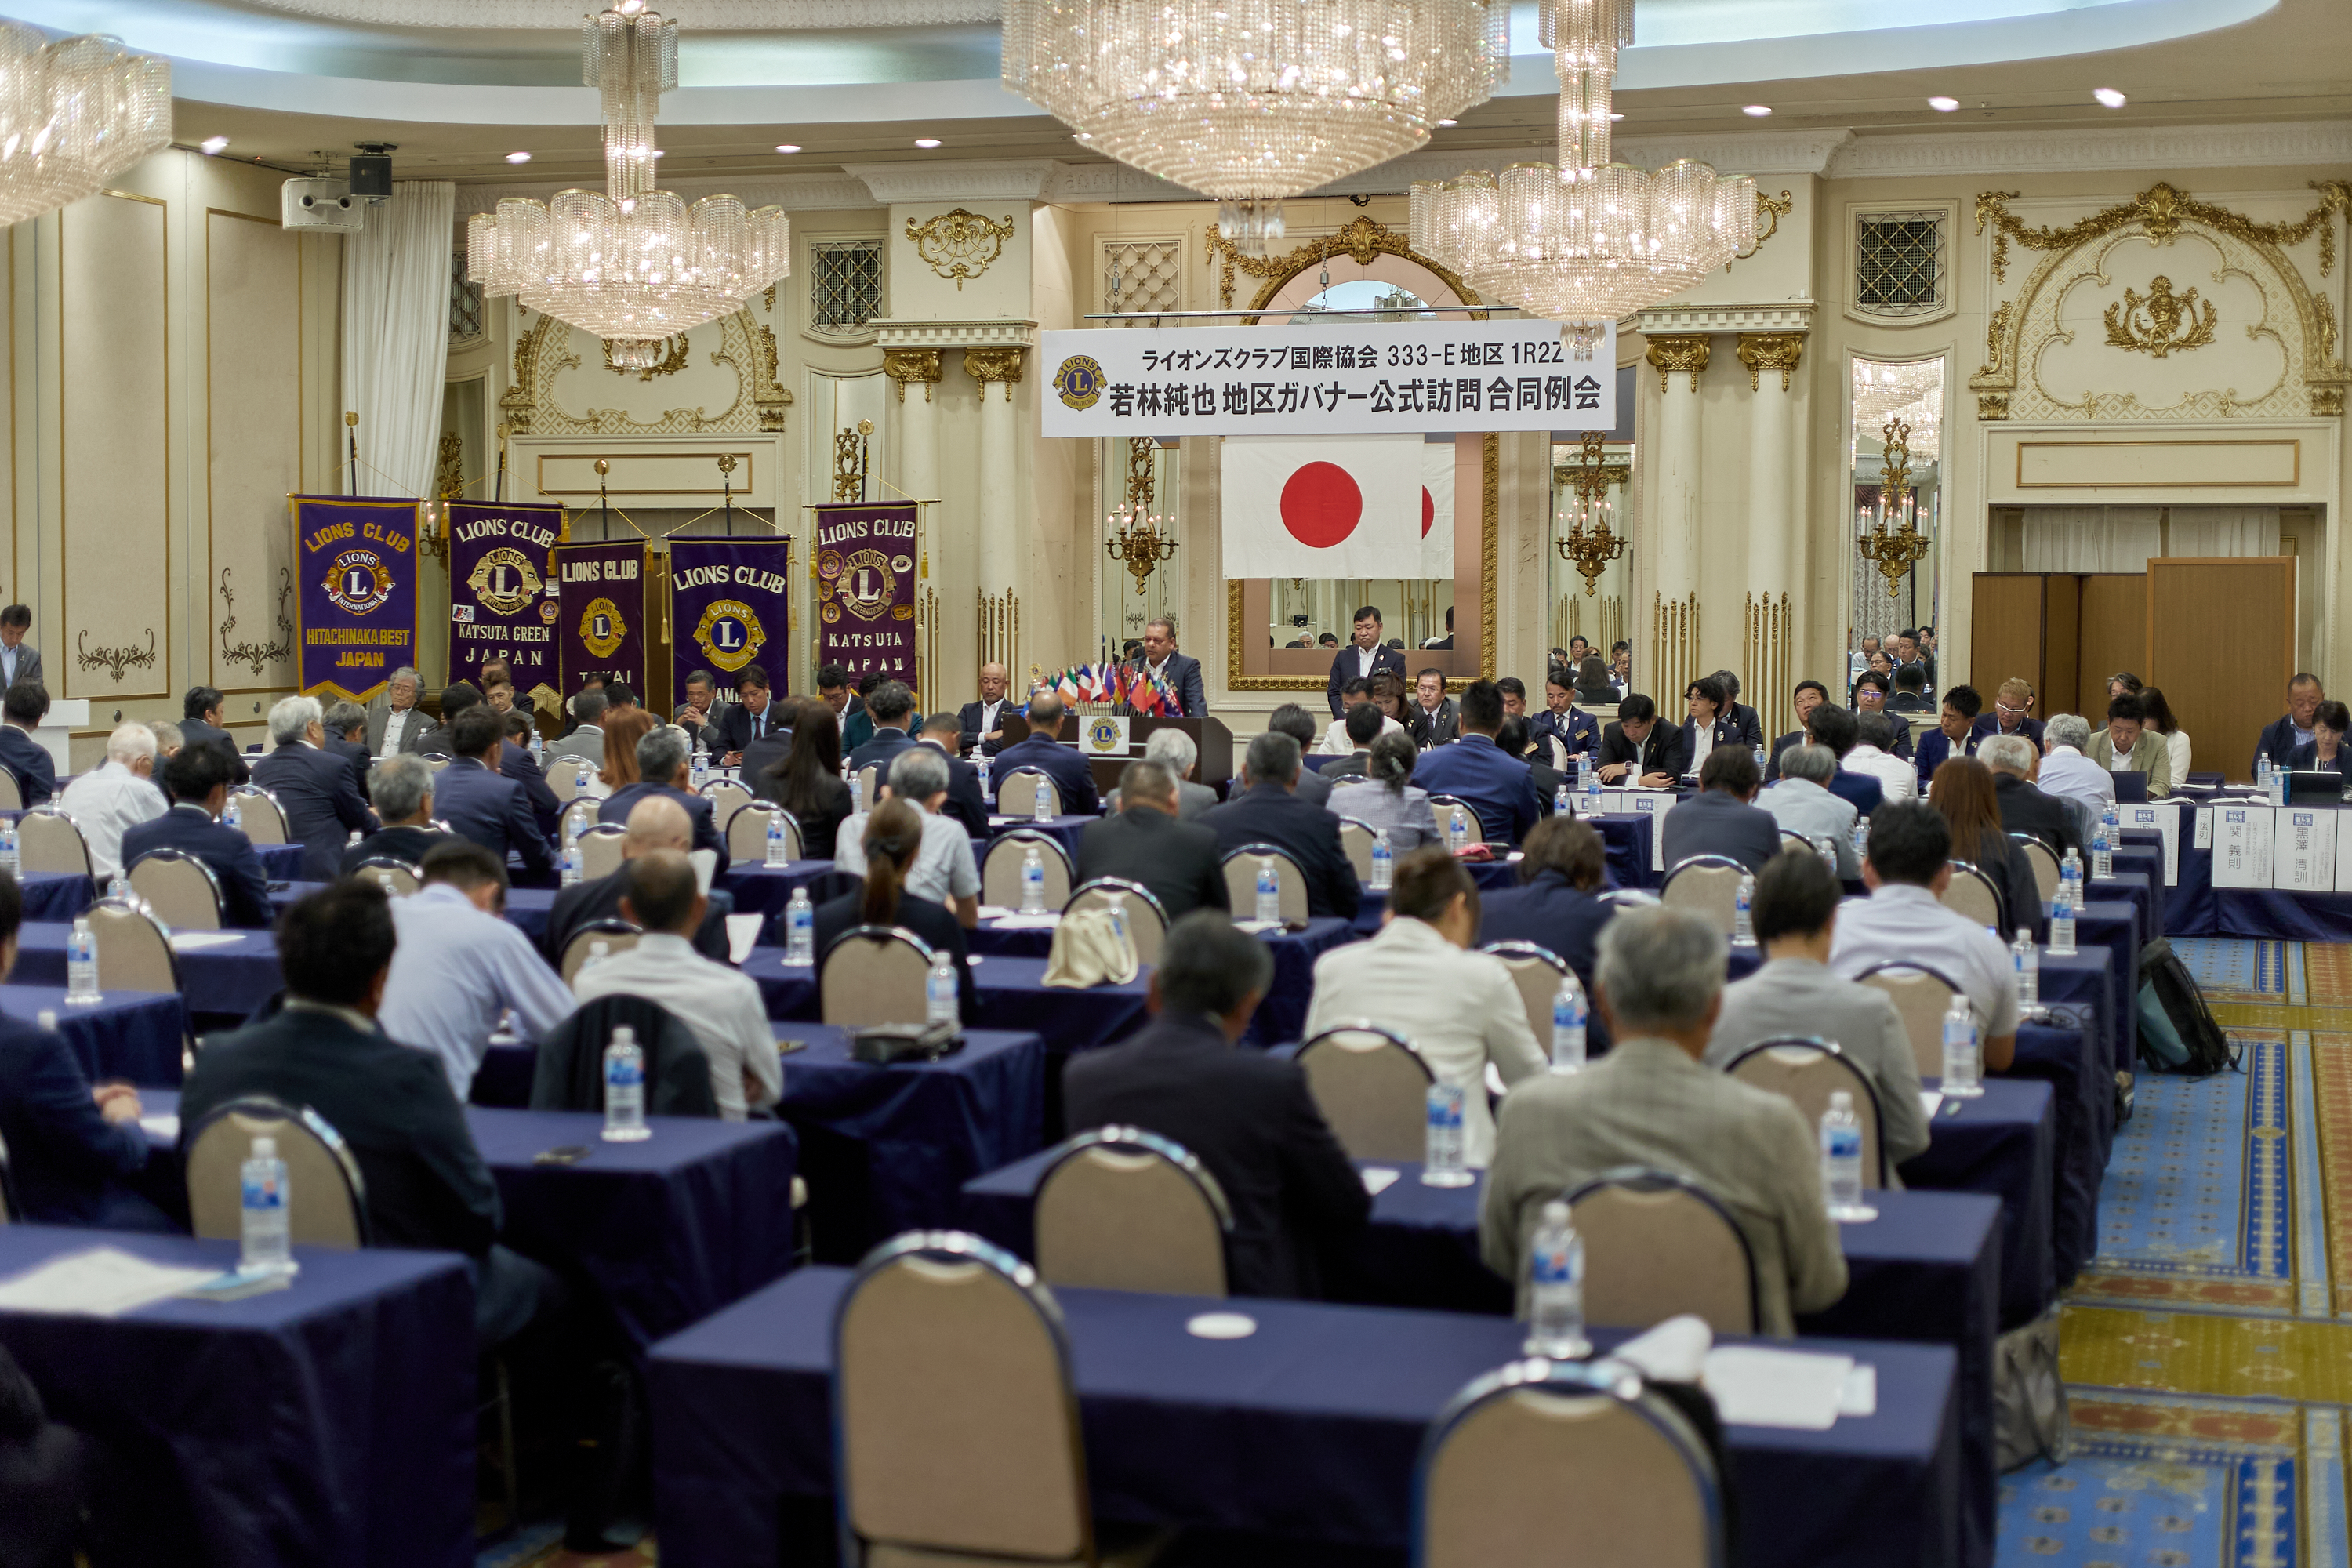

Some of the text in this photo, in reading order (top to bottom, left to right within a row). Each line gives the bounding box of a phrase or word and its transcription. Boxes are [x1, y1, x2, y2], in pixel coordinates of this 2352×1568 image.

[1064, 357, 1096, 369] LIONS
[1142, 344, 1378, 372] ライオンズクラブ国際協会
[1511, 341, 1565, 364] 1R2Z
[1074, 372, 1088, 391] L
[1065, 396, 1096, 406] INTERNATIONAL
[304, 522, 410, 553] LIONS CLUB
[455, 518, 556, 549] LIONS CLUB
[819, 518, 916, 546] LIONS CLUB
[339, 553, 376, 567] LIONS
[489, 551, 524, 564] LIONS
[851, 552, 884, 567] LIONS
[562, 559, 638, 583] LIONS CLUB
[673, 564, 786, 595] LIONS CLUB
[349, 572, 368, 595] L
[494, 566, 520, 597] L
[858, 569, 880, 601] L
[337, 597, 380, 611] INTERNATIONAL
[485, 596, 524, 610] INTERNATIONAL
[591, 601, 612, 614] LIONS
[710, 603, 748, 619] LIONS
[459, 623, 550, 641] KATSUTA GREEN
[595, 617, 609, 637] L
[719, 621, 740, 647] L
[829, 632, 902, 648] KATSUTA
[336, 652, 385, 667] JAPAN
[709, 650, 750, 664] INTERNATIONAL
[579, 670, 631, 684] TAI
[2199, 822, 2209, 840] 後列
